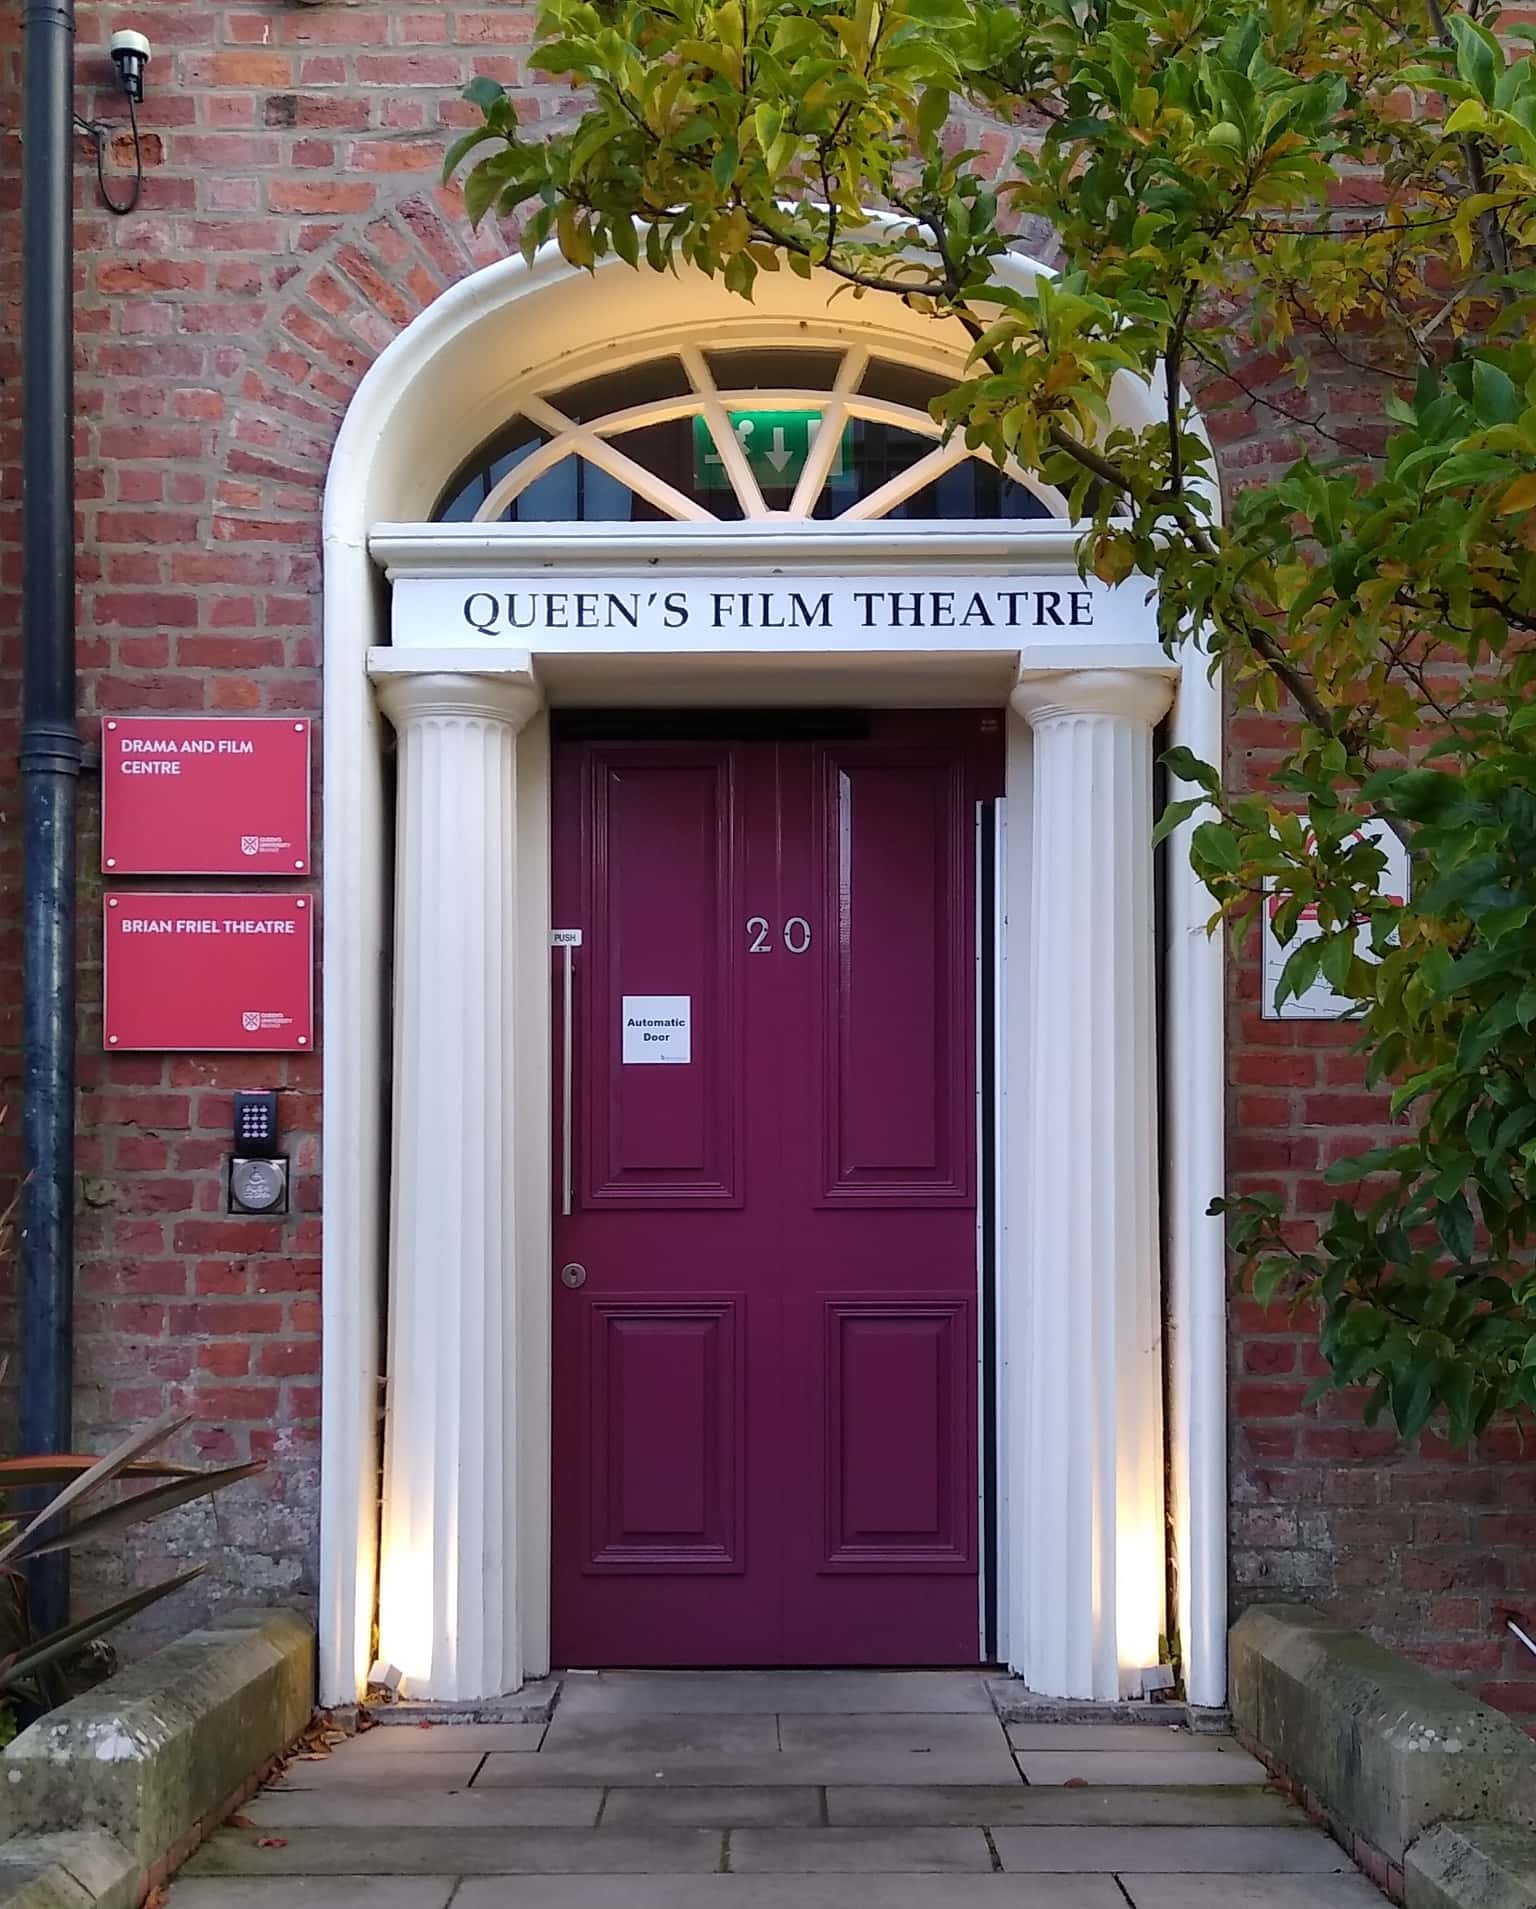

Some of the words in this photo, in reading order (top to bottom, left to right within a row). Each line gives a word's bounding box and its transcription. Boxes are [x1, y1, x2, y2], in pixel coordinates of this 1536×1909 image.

[463, 592, 689, 636] QUEEN'S
[710, 592, 834, 627] FILM
[853, 591, 1094, 627] THEATRE
[121, 739, 178, 753] DRAMA
[180, 740, 215, 753] AND
[218, 740, 253, 753] FILM
[121, 761, 181, 774] CENTRE
[121, 919, 172, 933] BRIAN
[176, 920, 220, 934] FRIEL
[223, 920, 295, 934] THEATRE
[554, 933, 577, 942] PUSH
[745, 916, 812, 954] 20
[627, 1018, 686, 1027] Automatic
[643, 1032, 671, 1041] Door
